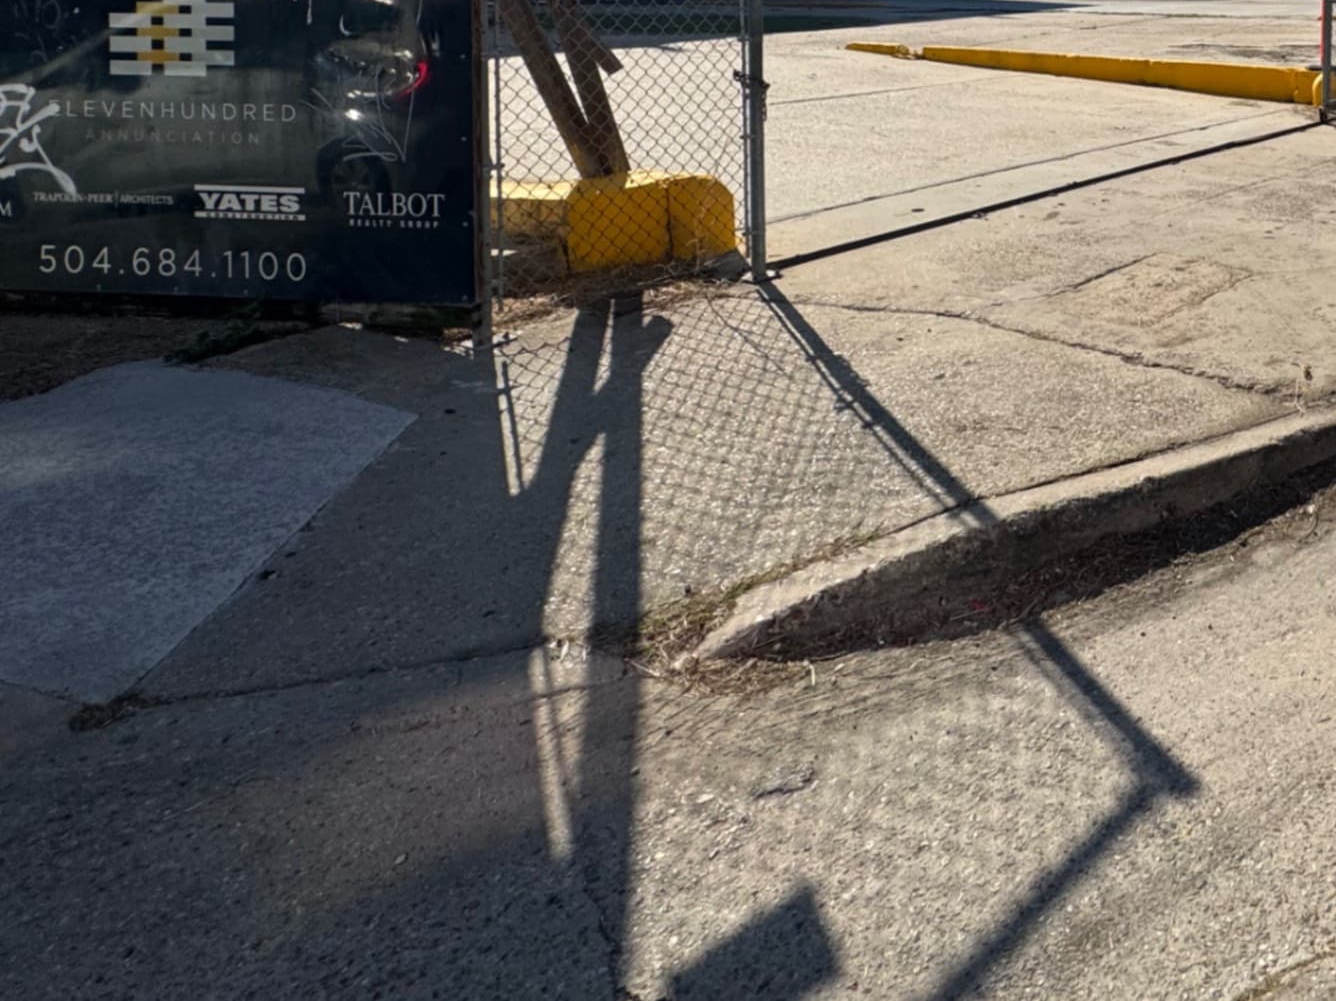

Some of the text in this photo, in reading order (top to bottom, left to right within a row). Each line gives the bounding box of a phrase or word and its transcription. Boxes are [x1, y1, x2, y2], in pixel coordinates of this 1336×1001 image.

[86, 127, 259, 144] ANNUNCIATION
[198, 192, 301, 213] YATES
[343, 191, 446, 218] TALBOT
[39, 244, 307, 282] 504.684.1100
